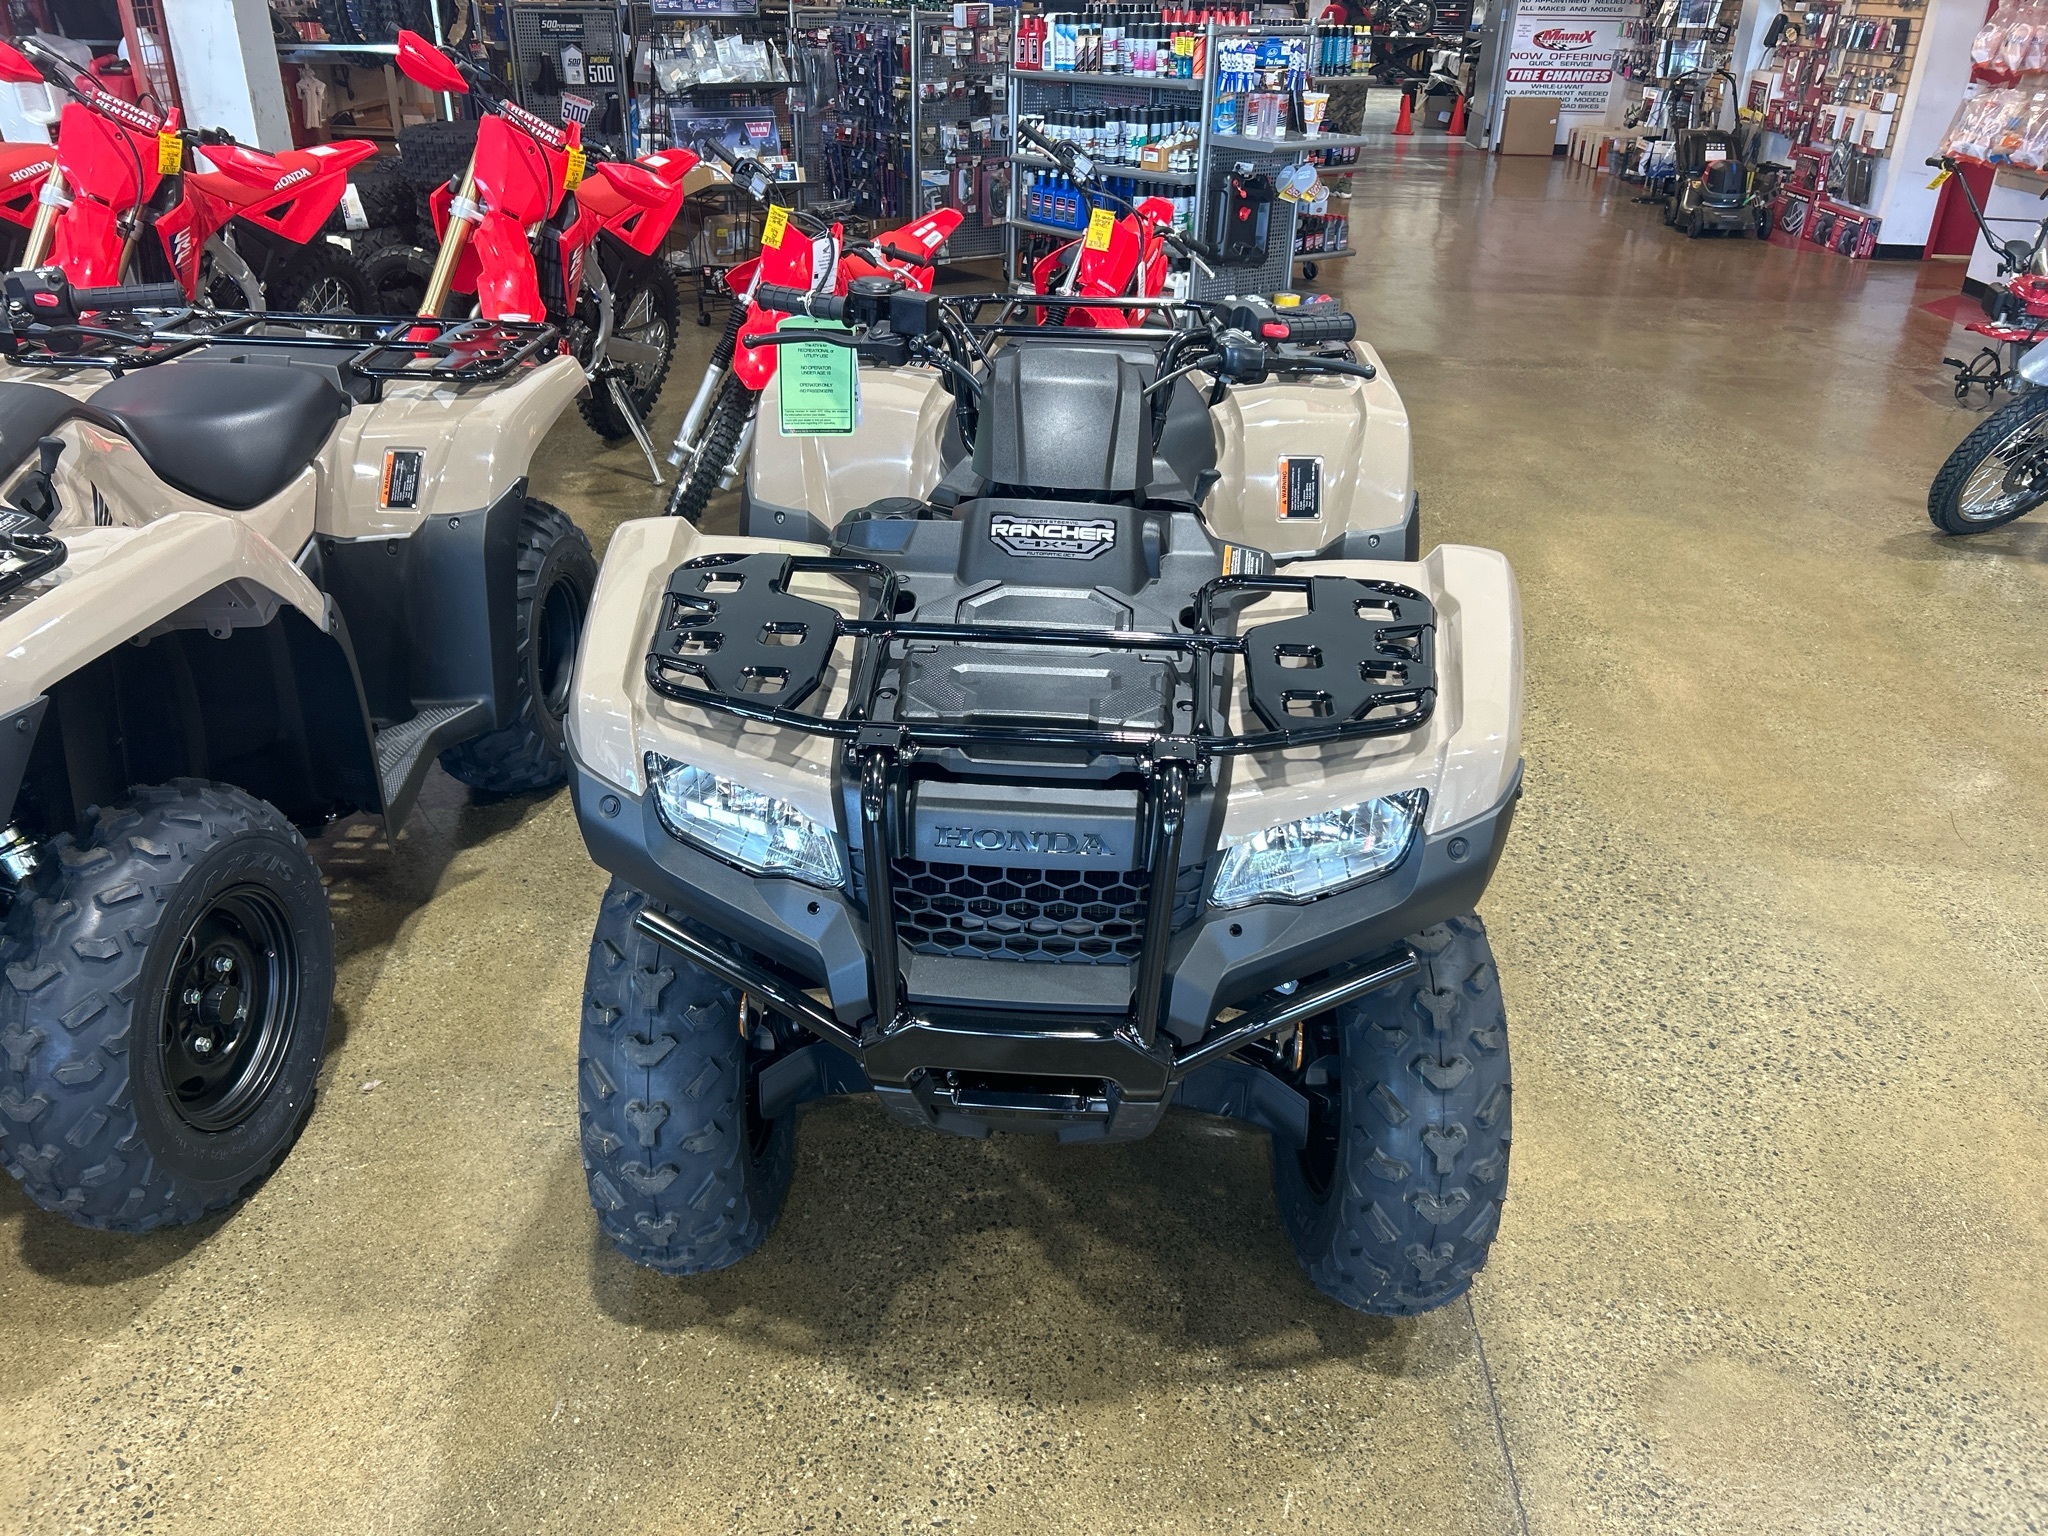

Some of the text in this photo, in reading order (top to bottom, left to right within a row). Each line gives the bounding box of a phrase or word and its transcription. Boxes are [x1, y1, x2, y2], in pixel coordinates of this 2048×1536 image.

[1510, 52, 1612, 61] NOW OFFERING
[588, 65, 615, 83] 500
[1509, 70, 1610, 82] TIRE CHANGES
[95, 100, 153, 130] RENTHAL
[97, 90, 158, 123] RENTHAL
[563, 101, 589, 125] 500
[510, 105, 562, 138] RENTHAL
[9, 161, 52, 182] HONDA
[991, 524, 1115, 542] RANCHER
[934, 826, 1116, 856] HONDA
